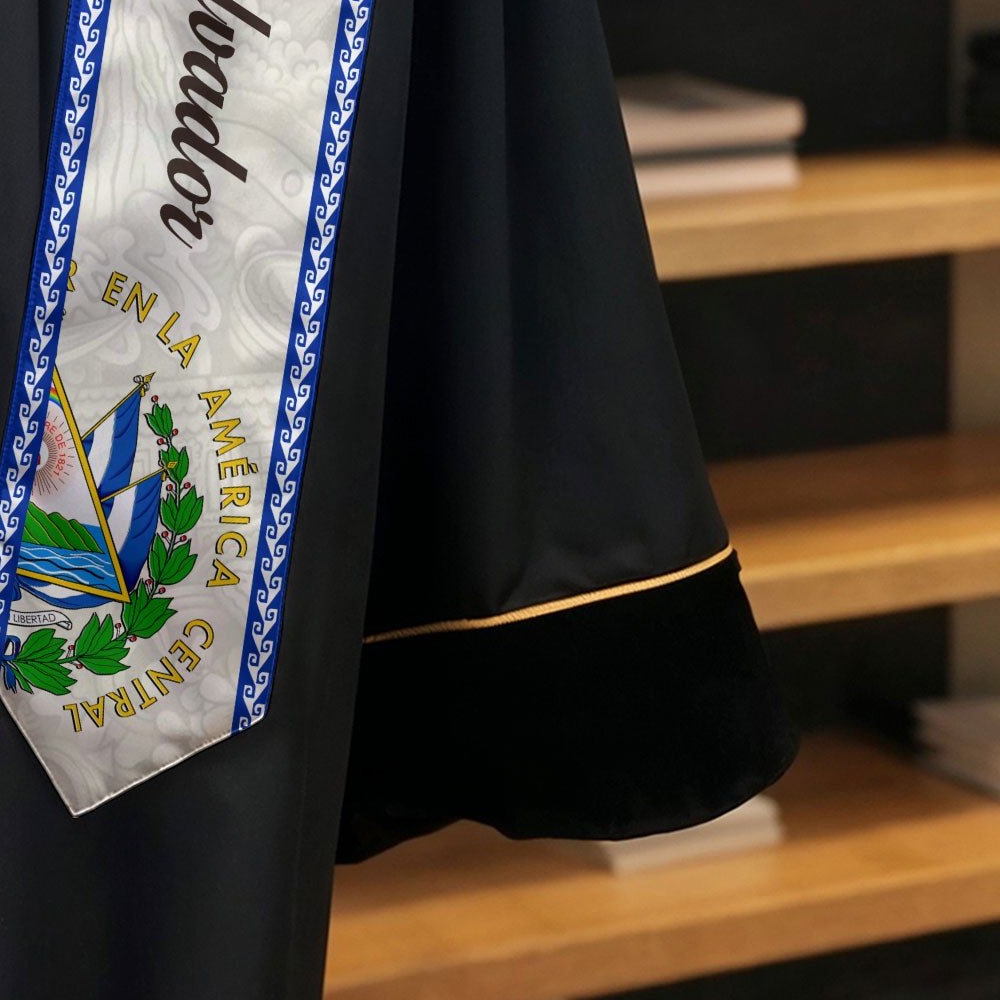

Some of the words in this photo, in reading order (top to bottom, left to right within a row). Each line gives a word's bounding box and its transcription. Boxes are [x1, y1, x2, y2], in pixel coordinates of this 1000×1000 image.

[102, 271, 158, 323] EN
[156, 311, 201, 369] LA
[53, 453, 66, 477] 1821
[55, 433, 67, 450] DE
[197, 388, 259, 588] AMÉRICA
[13, 613, 56, 624] LIBERTAD
[63, 618, 214, 732] CENTRAL
